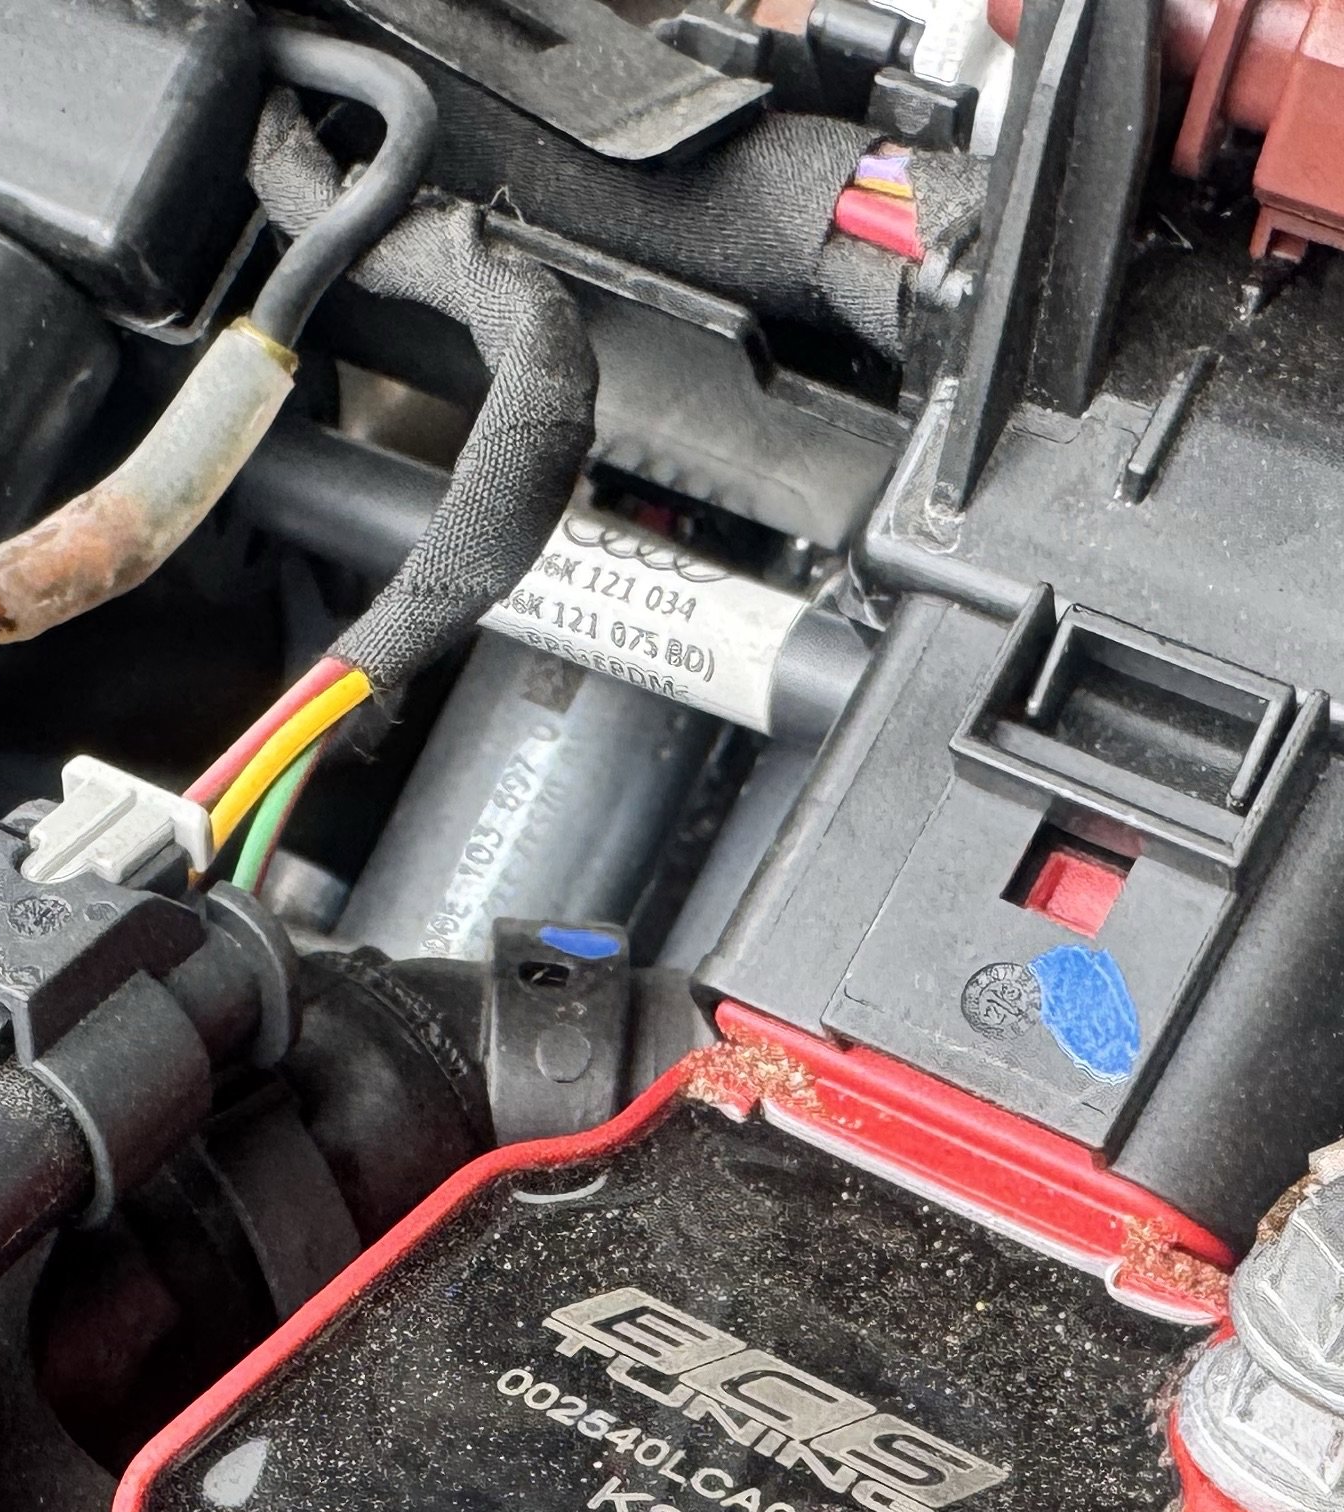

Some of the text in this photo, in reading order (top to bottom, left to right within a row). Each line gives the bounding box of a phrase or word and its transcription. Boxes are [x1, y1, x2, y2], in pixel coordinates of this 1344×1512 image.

[583, 566, 637, 604] 121
[646, 584, 698, 623] 034
[552, 600, 599, 640] 121
[611, 620, 661, 660] 075
[551, 1286, 1012, 1509] ECS
